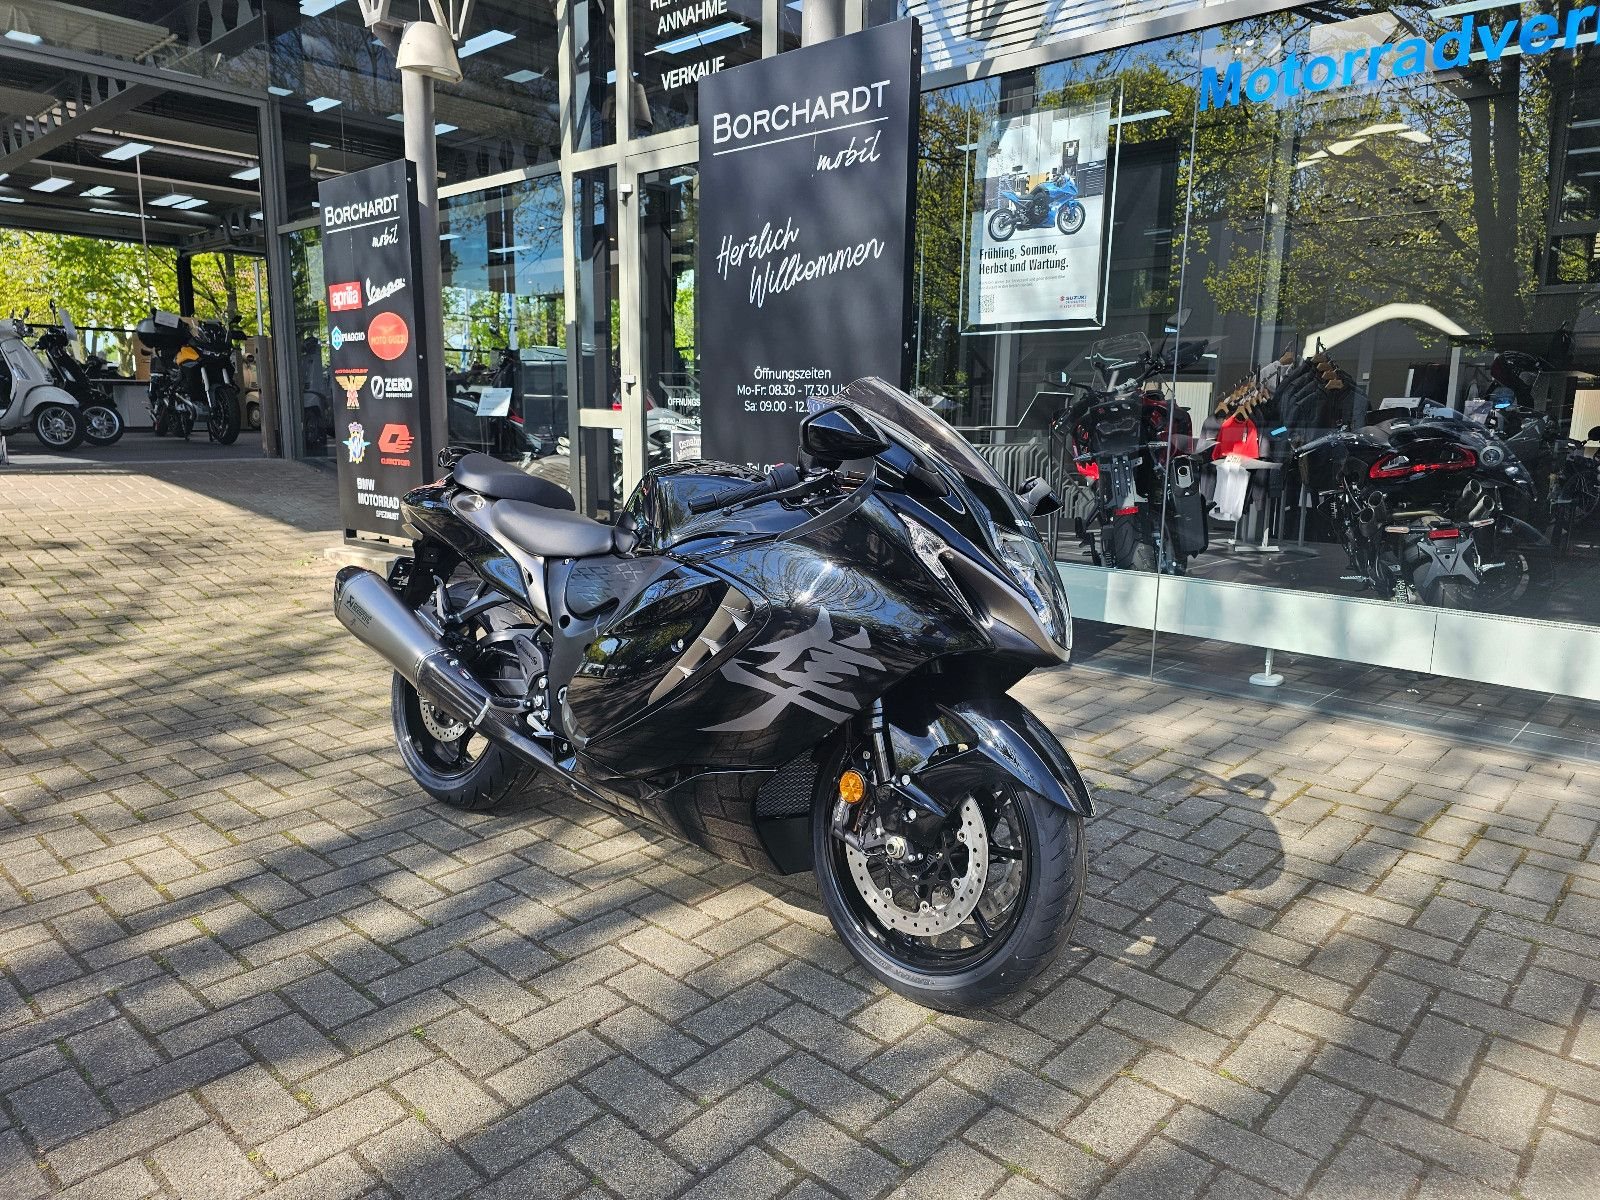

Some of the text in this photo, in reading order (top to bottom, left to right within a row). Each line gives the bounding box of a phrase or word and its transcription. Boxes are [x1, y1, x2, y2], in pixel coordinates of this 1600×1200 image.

[657, 0, 728, 36] ANNAHME
[1200, 4, 1600, 112] Motorradver
[713, 79, 891, 144] BORCHARDT
[816, 129, 882, 171] mobil
[324, 194, 400, 227] BORCHARDT
[371, 223, 399, 248] mobil
[716, 216, 800, 281] Herzlich
[979, 243, 1059, 261] Frühling, Sommer,
[749, 237, 885, 309] Willkommen
[978, 257, 1069, 275] Herbst und Wartung.
[753, 365, 832, 382] Öffnungszeiten
[384, 377, 413, 392] ZERO
[759, 400, 787, 413] 09.00
[356, 477, 375, 491] BMW
[357, 492, 400, 510] MOTORRAD
[1015, 519, 1034, 528] SUZ
